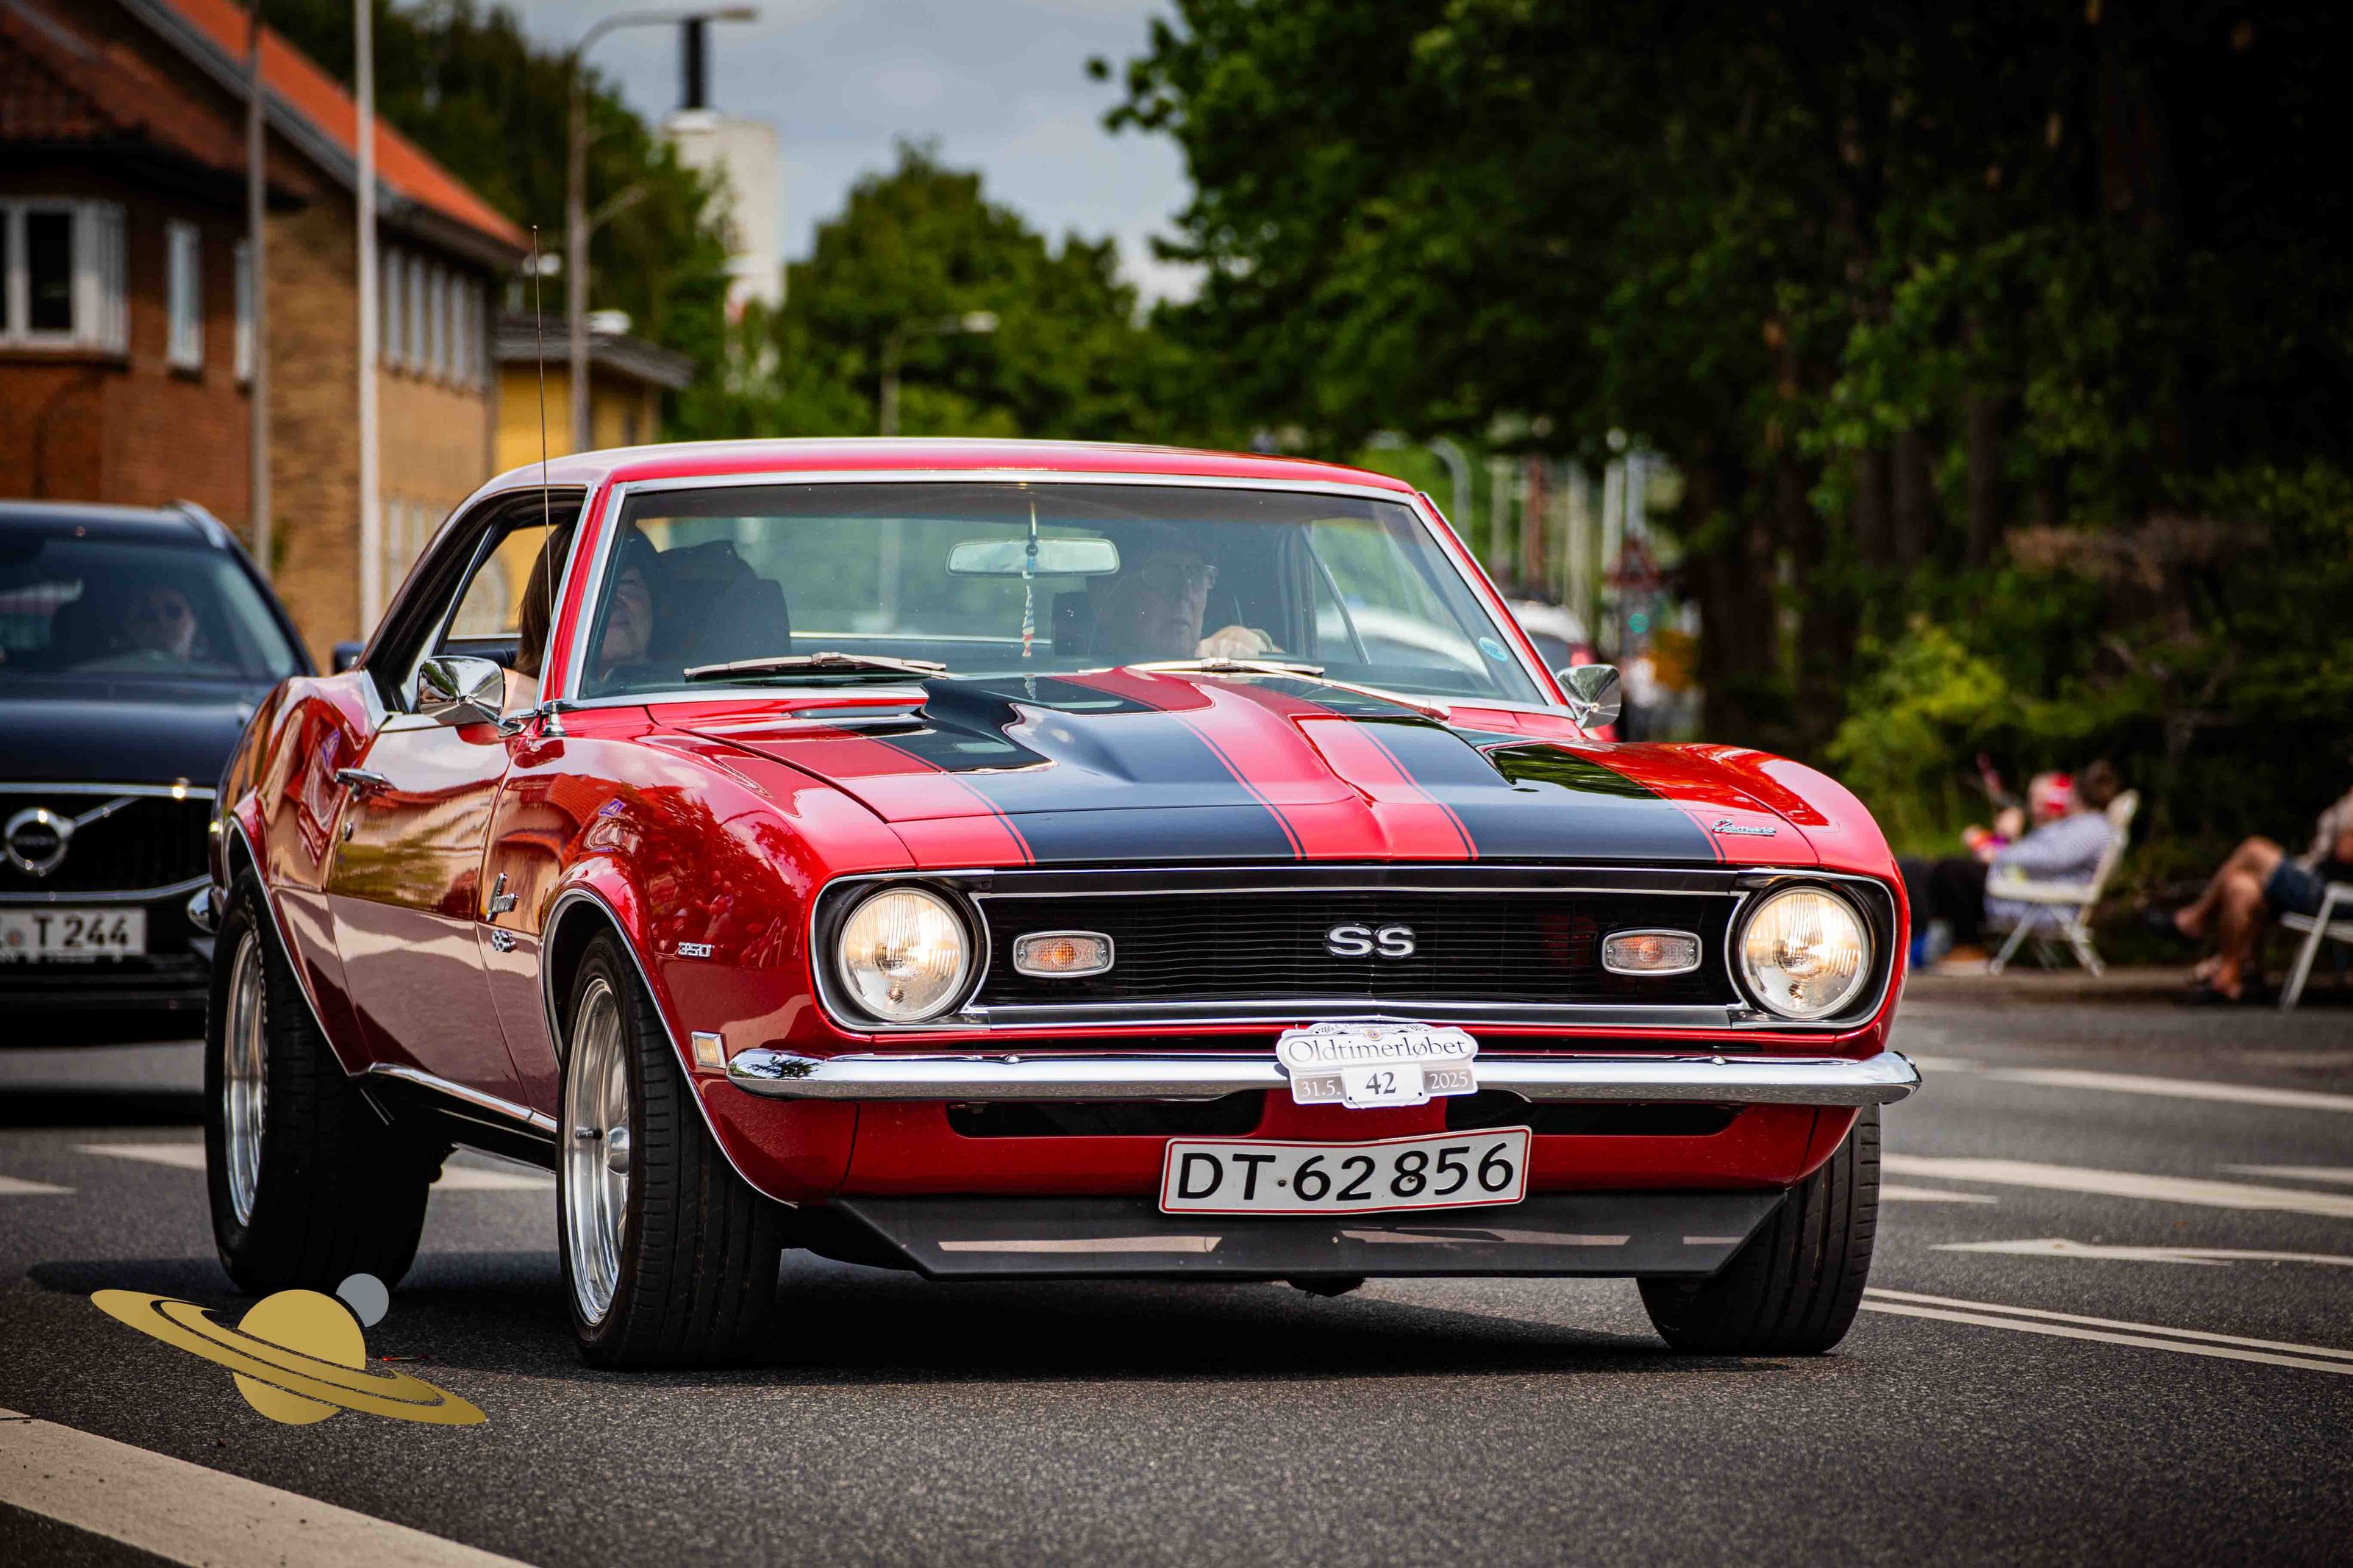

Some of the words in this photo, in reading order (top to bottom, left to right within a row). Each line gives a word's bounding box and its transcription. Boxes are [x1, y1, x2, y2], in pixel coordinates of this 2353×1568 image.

[32, 915, 54, 946] T
[64, 914, 128, 947] 244
[1328, 925, 1415, 957] SS
[679, 942, 712, 957] 350
[1289, 1037, 1468, 1062] Oldtimerløbet
[1301, 1080, 1341, 1097] 31.5.
[1365, 1072, 1397, 1095] 42
[1429, 1072, 1468, 1089] 2025
[1177, 1153, 1276, 1200] DT
[1293, 1155, 1376, 1201] 62
[1390, 1142, 1514, 1198] 856
